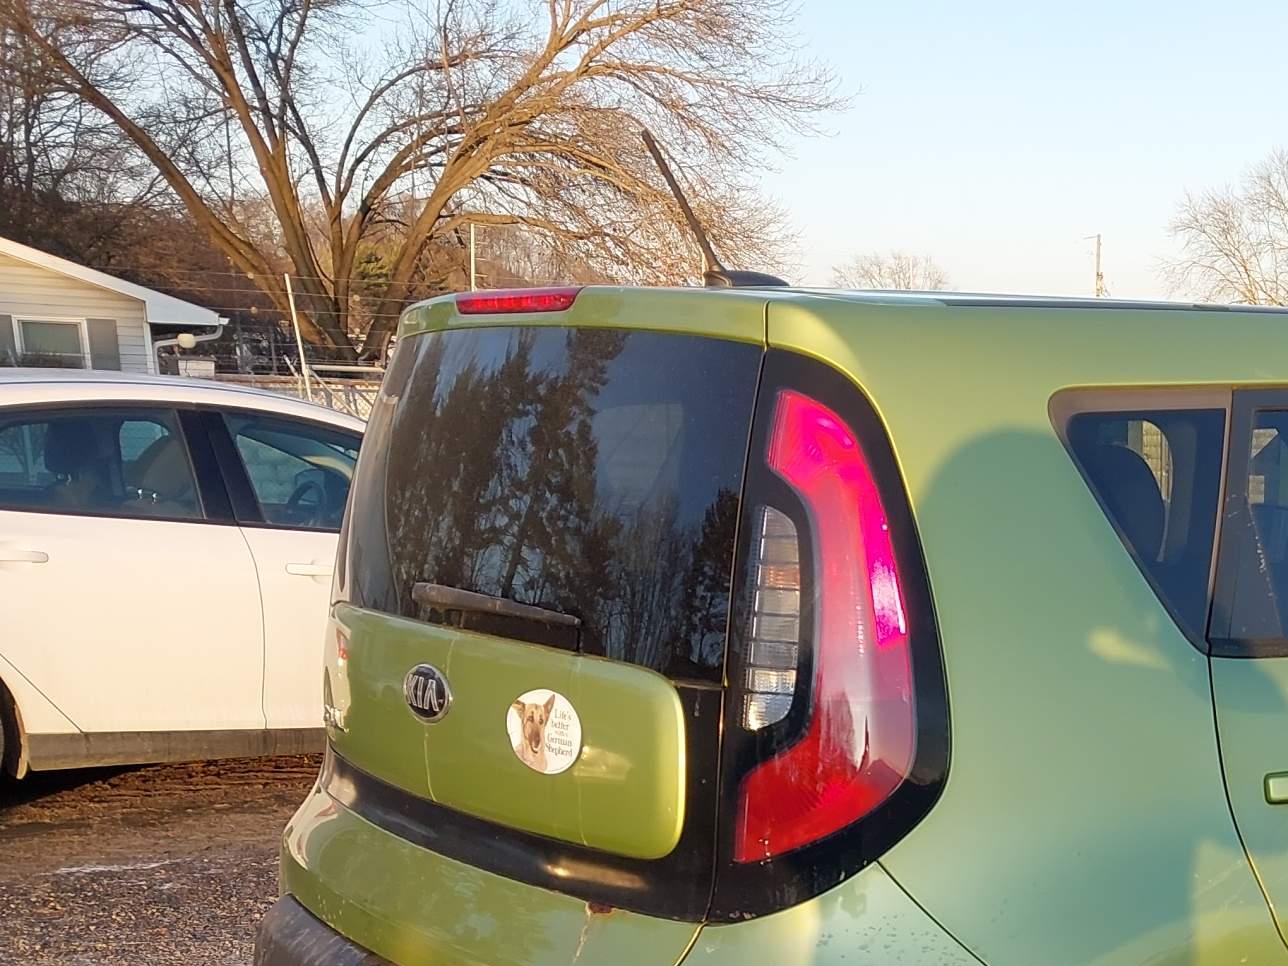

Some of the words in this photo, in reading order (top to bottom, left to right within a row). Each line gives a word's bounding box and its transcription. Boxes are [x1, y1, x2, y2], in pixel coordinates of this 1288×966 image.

[405, 674, 440, 712] KIA
[554, 709, 572, 721] Life's
[547, 733, 573, 748] German
[545, 743, 573, 757] Shepherd
